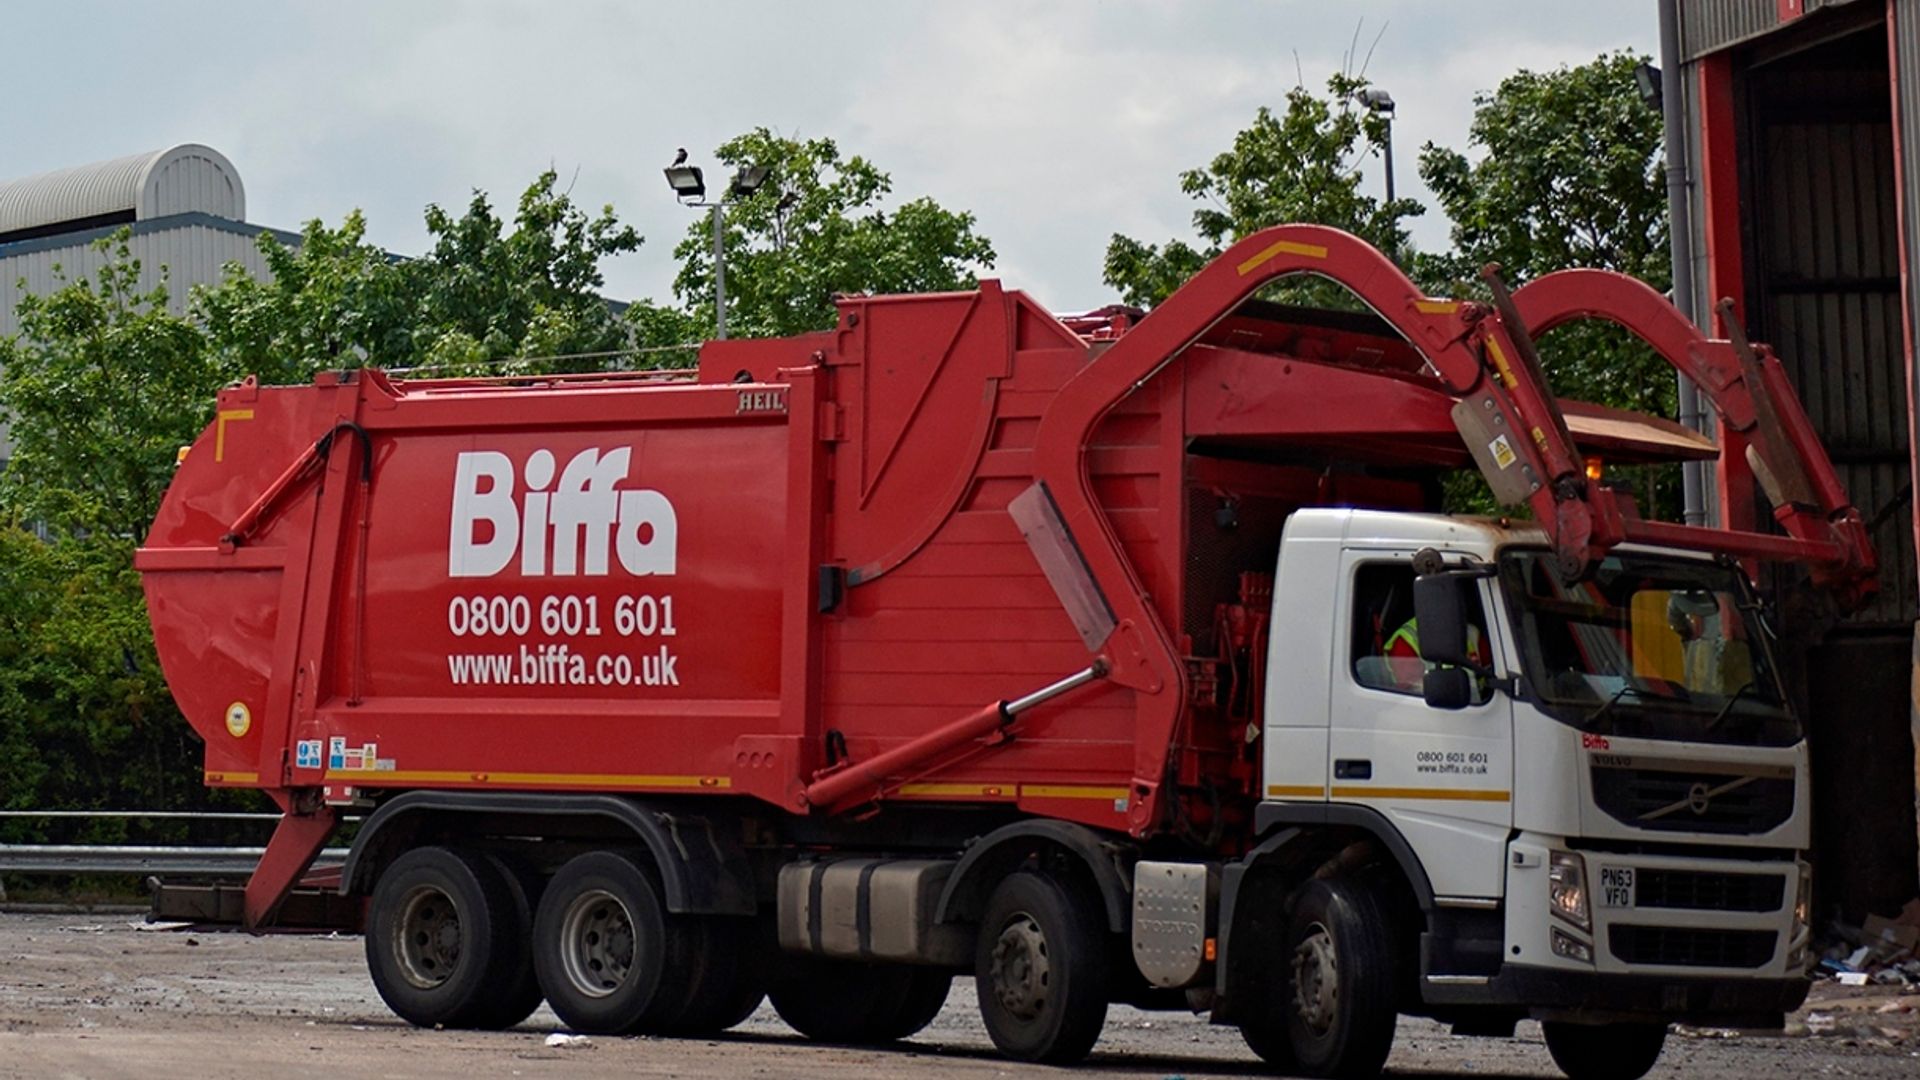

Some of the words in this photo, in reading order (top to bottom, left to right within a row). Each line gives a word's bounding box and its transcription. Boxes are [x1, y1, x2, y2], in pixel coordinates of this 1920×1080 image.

[739, 392, 783, 410] HEIL
[449, 446, 678, 577] Biffa
[449, 595, 531, 636] 0800
[540, 595, 601, 636] 601
[615, 595, 676, 636] 601
[448, 643, 679, 686] www.biffa.co.uk
[1416, 751, 1444, 762] 0800
[1446, 752, 1465, 763] 601
[1468, 752, 1488, 763] 601
[1601, 868, 1632, 887] PN63
